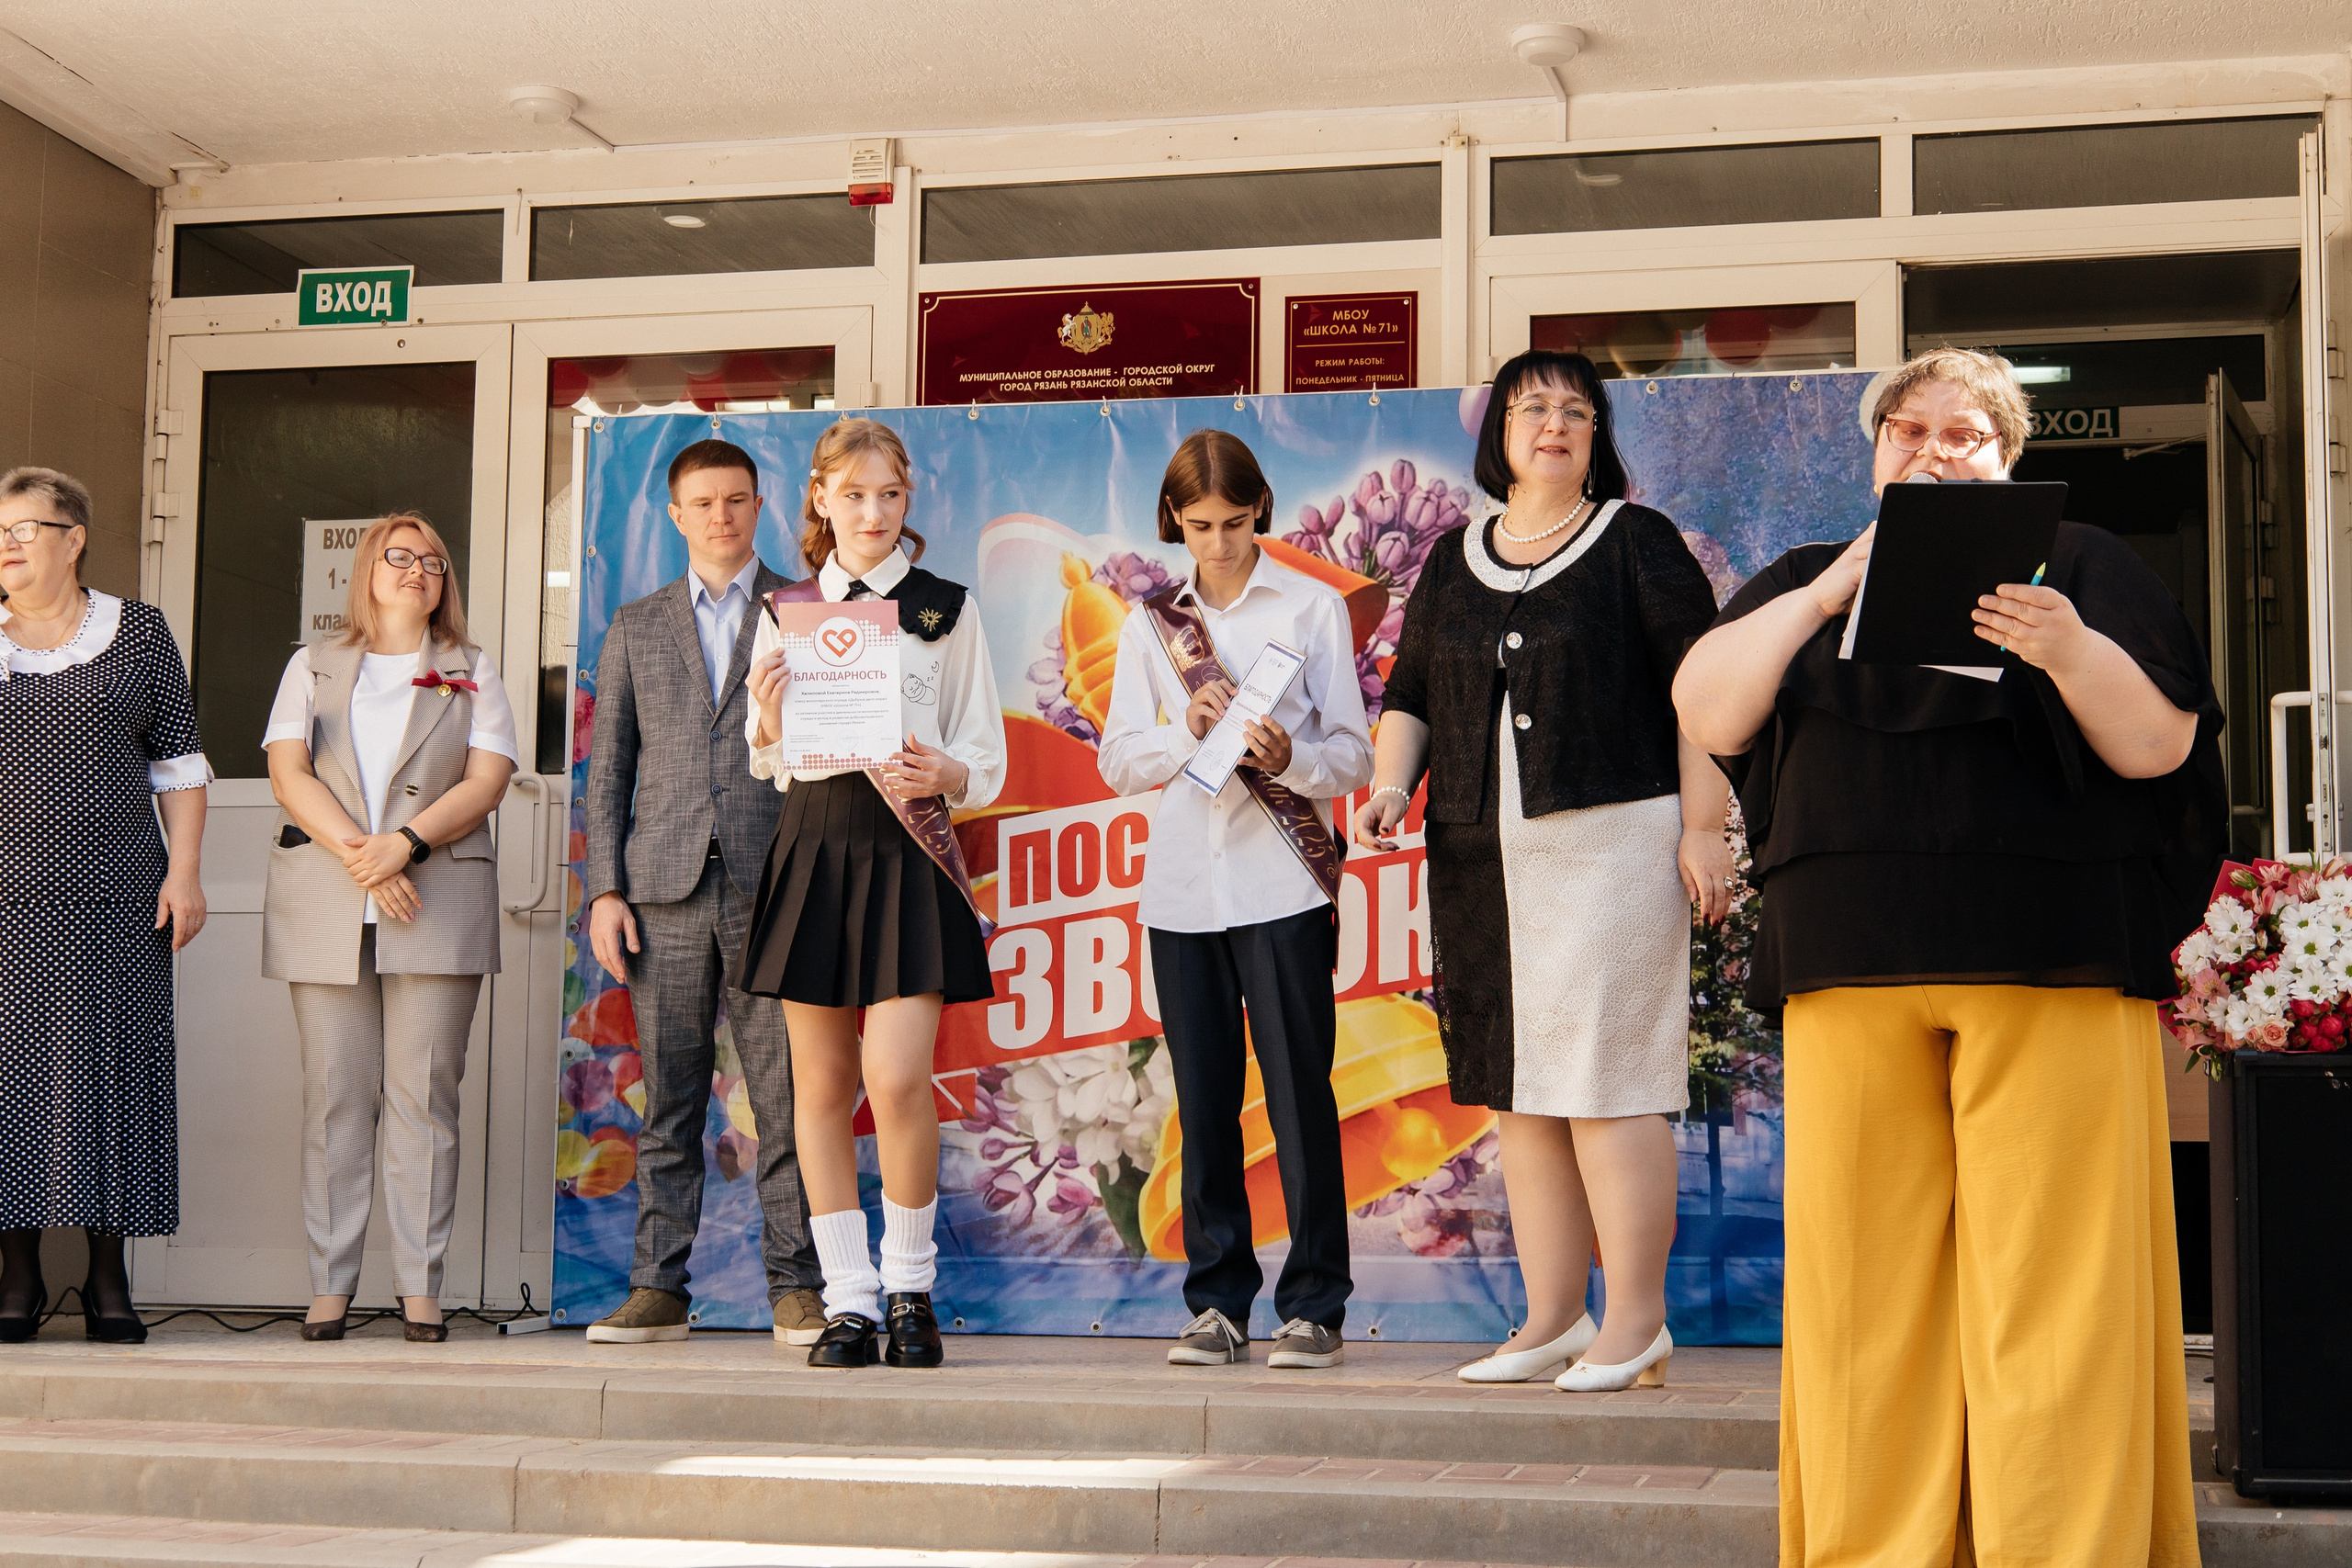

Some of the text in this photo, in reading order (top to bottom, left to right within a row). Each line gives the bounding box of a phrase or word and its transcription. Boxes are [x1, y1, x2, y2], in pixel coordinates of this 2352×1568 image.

[316, 280, 392, 317] ВХОД
[1332, 310, 1369, 321] МБОУ
[1304, 324, 1357, 336] «ШКОЛА
[1315, 357, 1385, 367] РЕЖИМ РАБОТЫ:
[959, 370, 1042, 383] МУНИЦИПАЛЬНОЕ
[1044, 367, 1112, 379] ОБРАЗОВАНИЕ
[1123, 364, 1182, 377] ГОРОДСКОЙ
[1185, 364, 1216, 374] ОКРУГ
[1295, 376, 1357, 385] ПОНЕДЕЛЬНИК
[1365, 374, 1405, 382] ПЯТНИЦА
[1000, 377, 1173, 392] ГОРОД РЯЗАНЬ РЯЗАНСКОЙ ОБЛАСТИ
[328, 568, 336, 590] 1
[794, 670, 888, 682] БЛАГОДАРНОСТЬ
[906, 801, 955, 856] 2025
[1280, 808, 1336, 859] 2025
